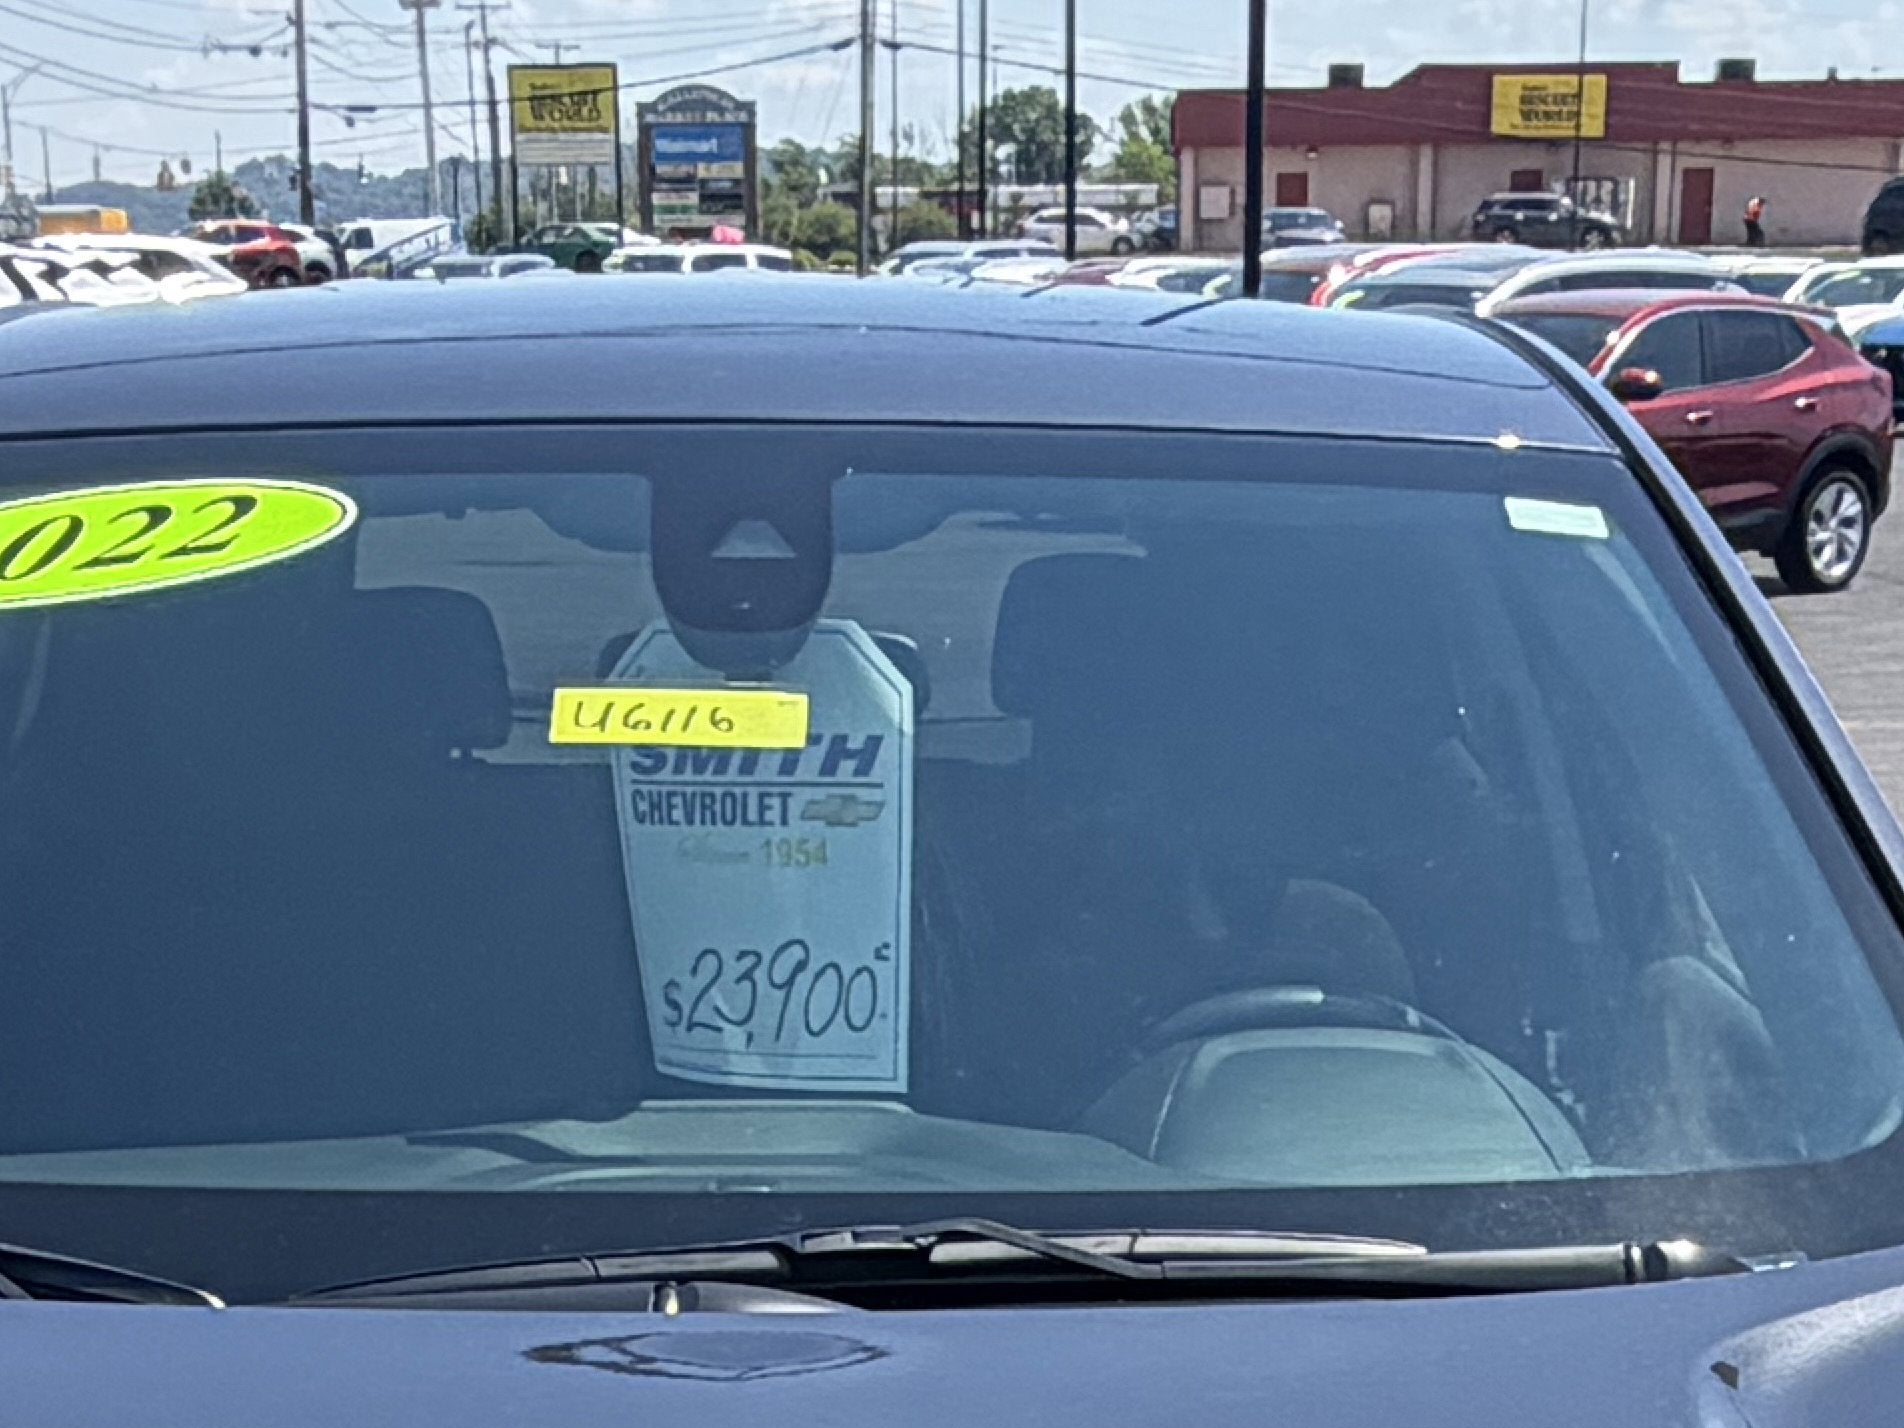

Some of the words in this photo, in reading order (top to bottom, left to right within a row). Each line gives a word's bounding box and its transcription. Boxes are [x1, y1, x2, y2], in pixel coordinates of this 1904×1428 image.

[628, 734, 884, 779] SMITH
[631, 790, 795, 828] CHEVROLET
[761, 837, 828, 868] 1954
